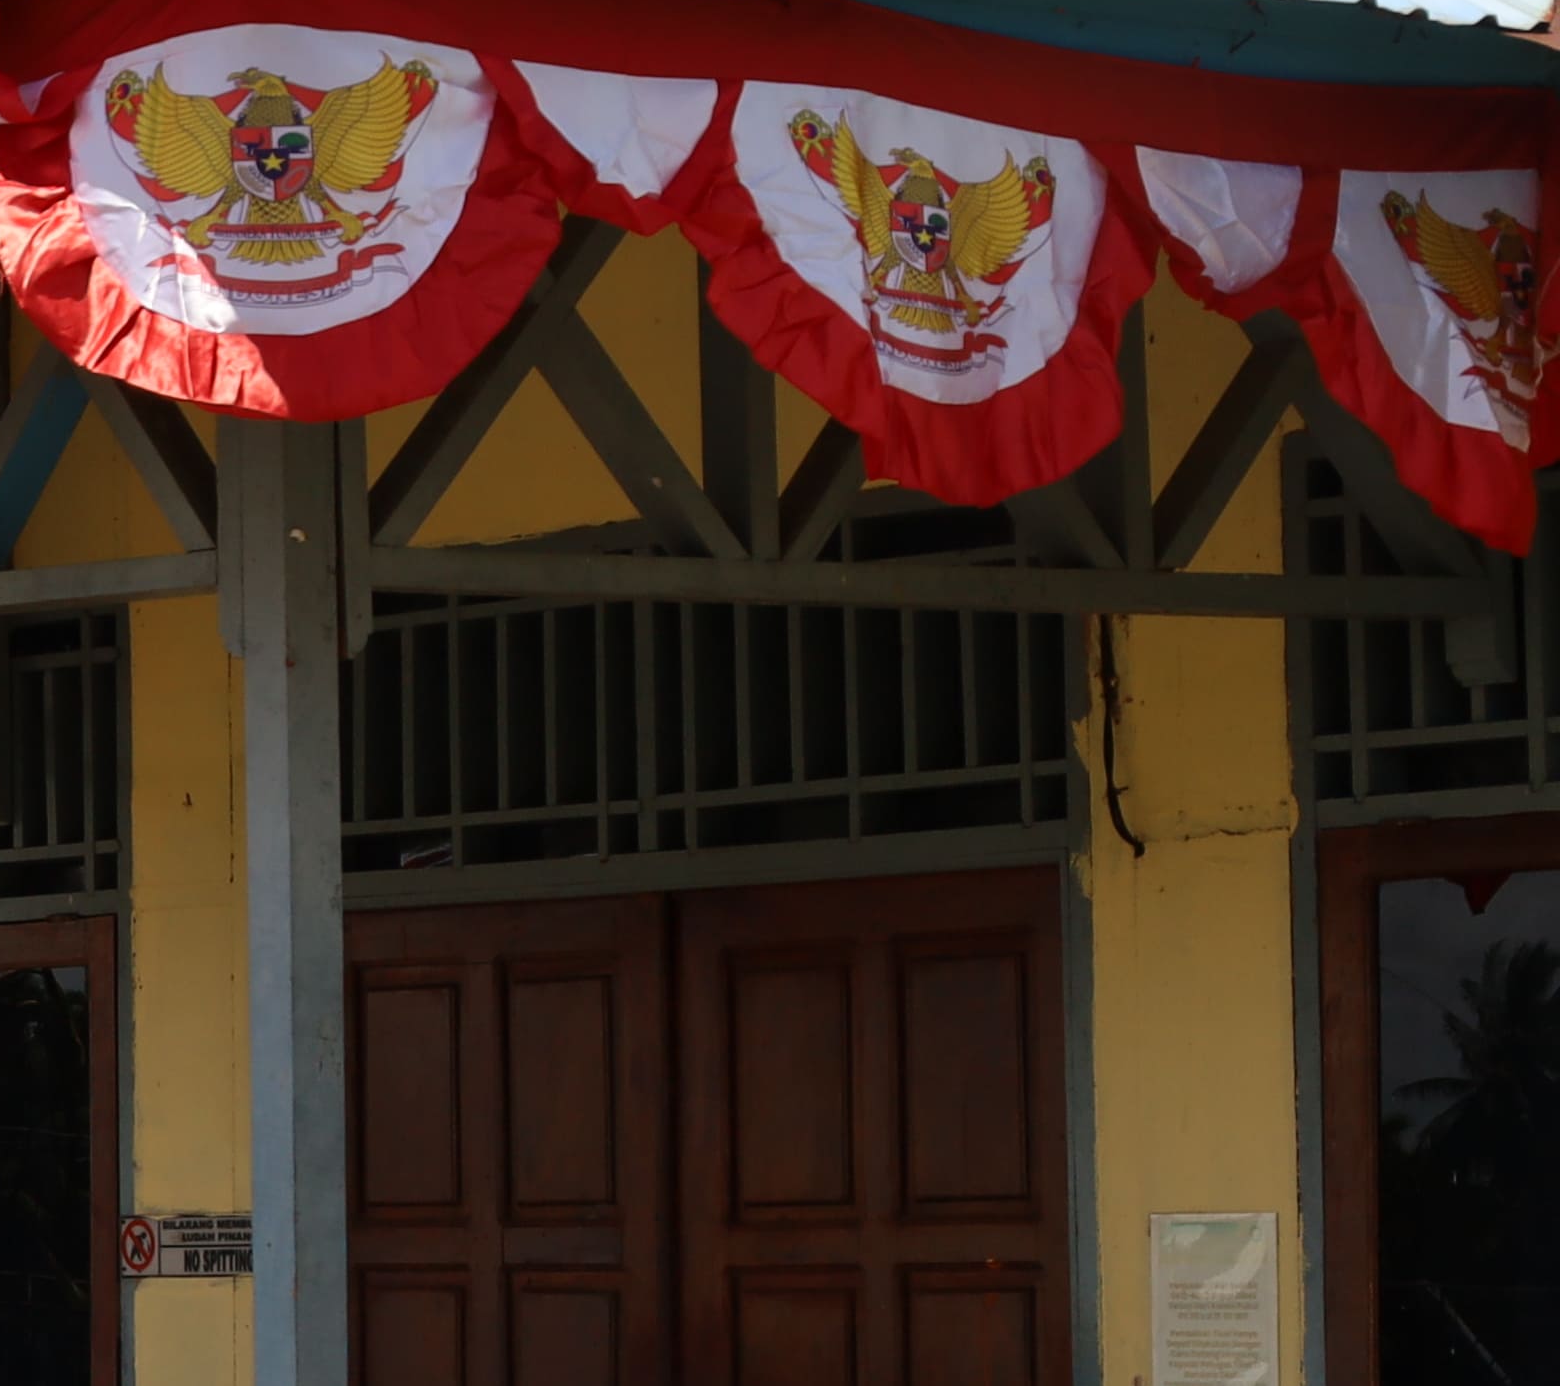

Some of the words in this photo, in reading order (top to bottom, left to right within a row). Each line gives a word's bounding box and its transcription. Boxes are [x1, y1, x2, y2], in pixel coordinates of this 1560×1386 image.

[162, 1220, 215, 1230] DILARANG
[182, 1232, 215, 1242] LUDAH
[218, 1232, 252, 1242] PINAN
[184, 1250, 200, 1272] NO
